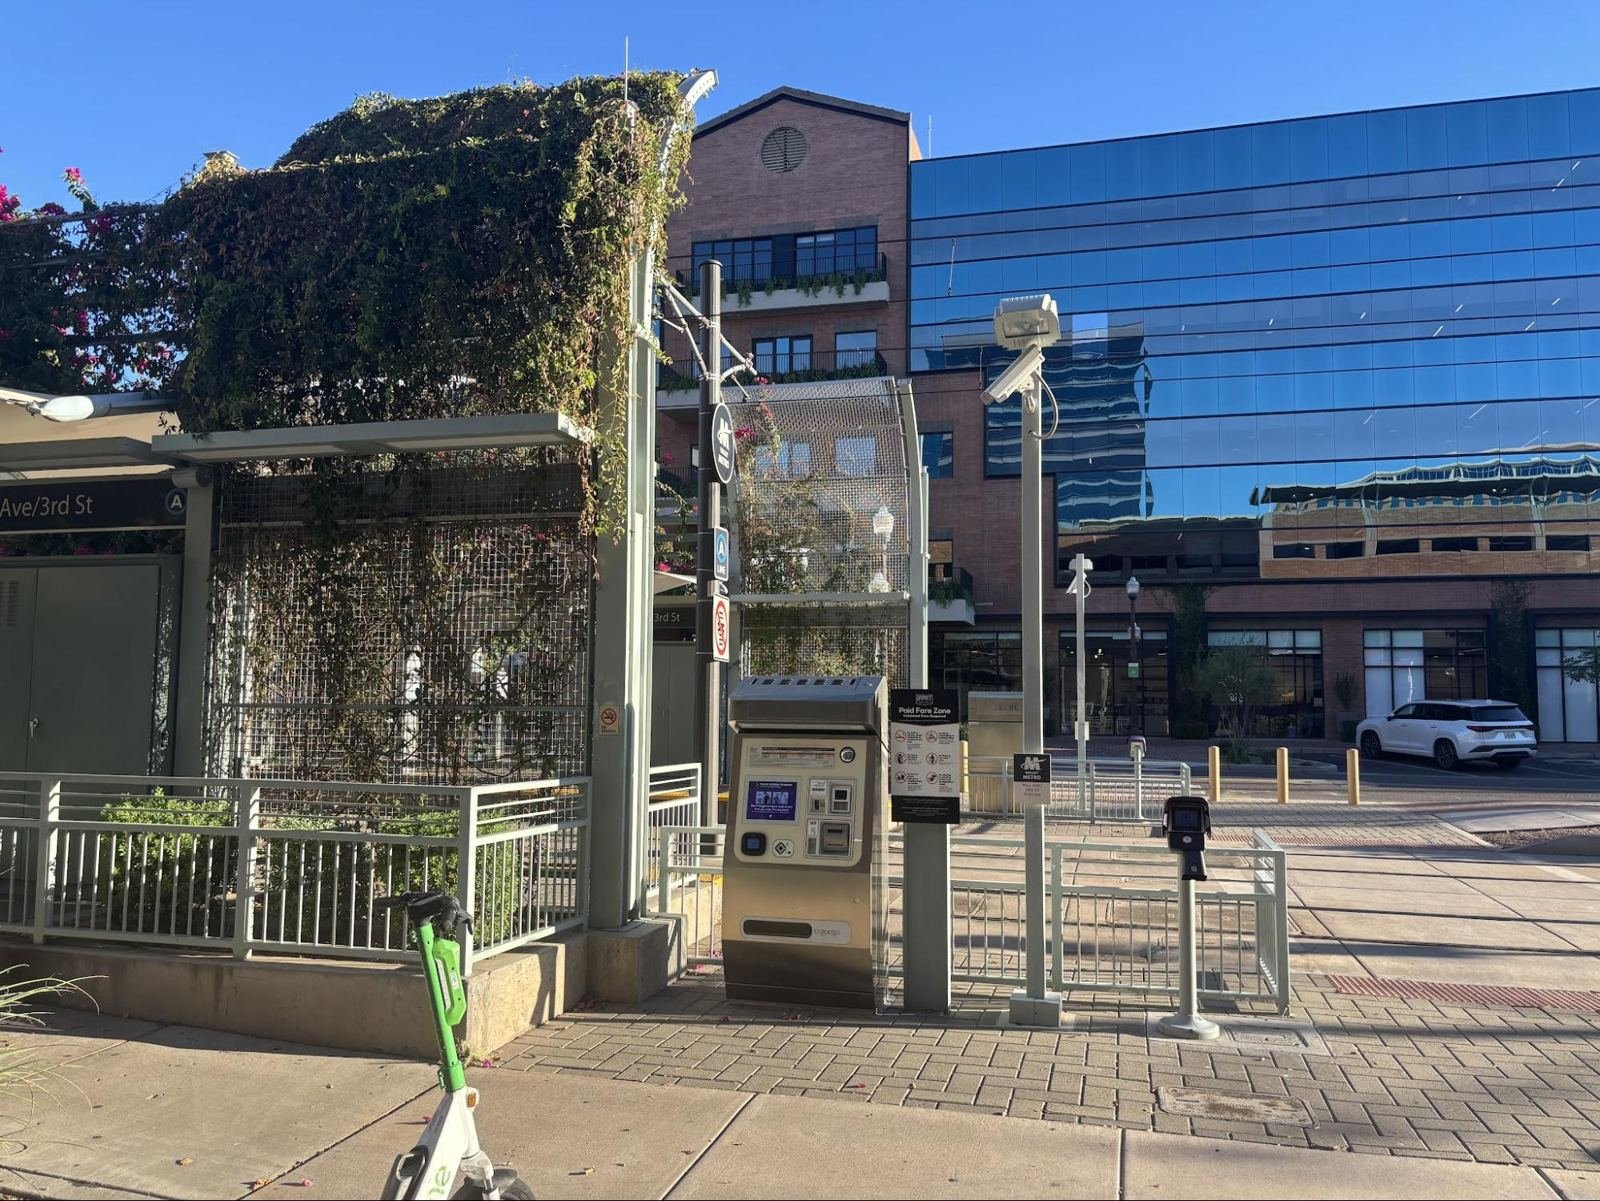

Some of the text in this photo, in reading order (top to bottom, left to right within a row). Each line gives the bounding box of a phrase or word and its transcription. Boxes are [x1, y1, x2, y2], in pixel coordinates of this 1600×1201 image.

[0, 494, 94, 518] Ave/3rd St
[170, 494, 183, 509] A
[718, 541, 725, 556] A
[717, 563, 727, 575] LINE
[654, 612, 680, 623] 3rd St
[898, 706, 951, 715] Paid Fare Zone
